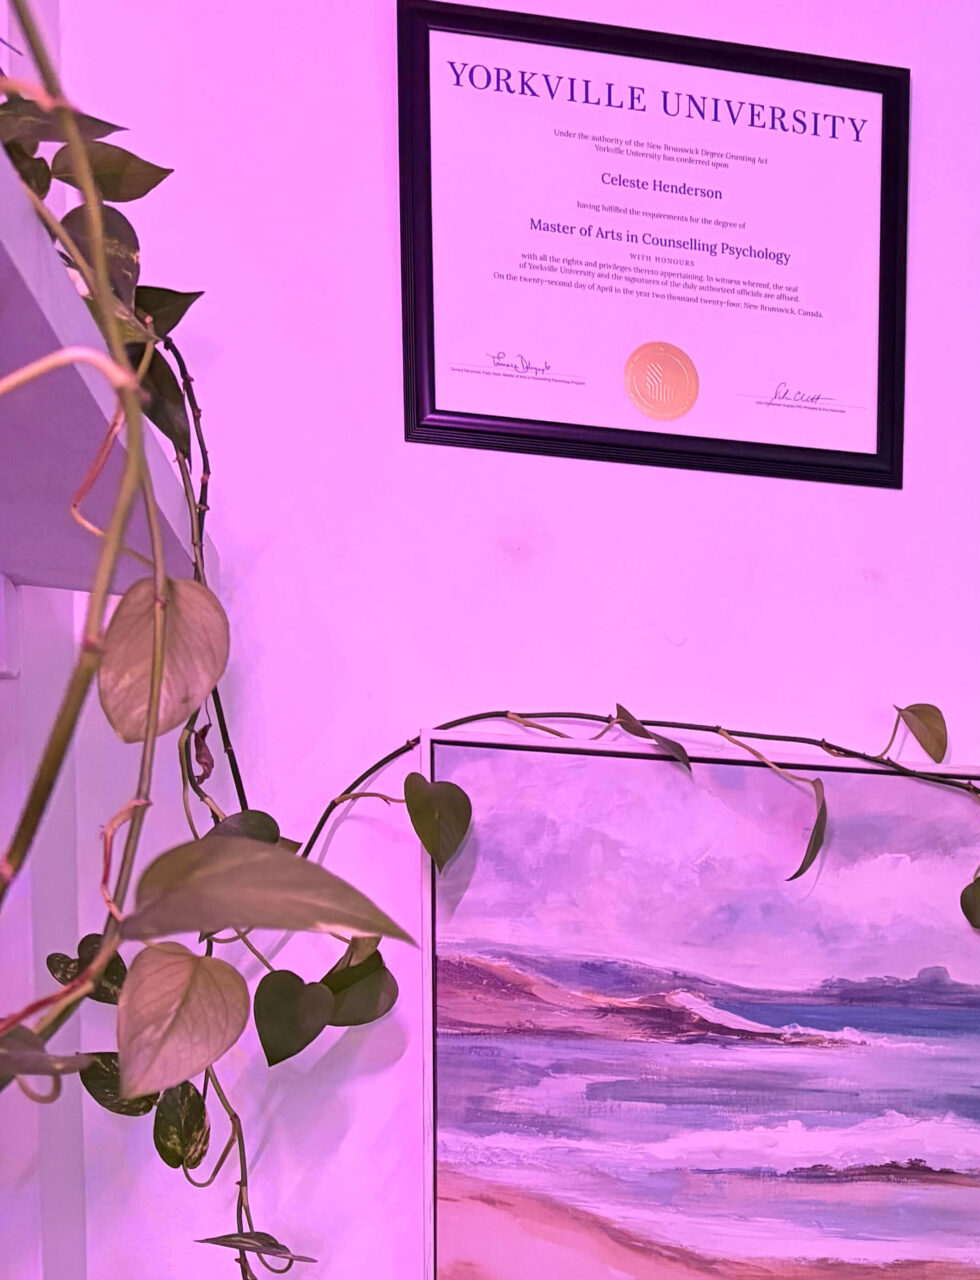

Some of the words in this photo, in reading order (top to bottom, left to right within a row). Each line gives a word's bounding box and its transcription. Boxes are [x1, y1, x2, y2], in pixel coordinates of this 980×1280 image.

[447, 60, 647, 113] YORKVILLE
[660, 90, 869, 143] UNIVERSITY
[553, 128, 576, 138] Under
[577, 131, 589, 140] the
[590, 135, 623, 148] authority
[624, 138, 632, 149] of
[633, 139, 644, 148] the
[646, 141, 662, 150] New
[663, 143, 699, 154] Brunswick
[700, 148, 724, 159] Degree
[725, 151, 755, 164] Granting
[757, 156, 767, 164] Act
[594, 143, 624, 155] Yorkville
[625, 148, 661, 161] University
[662, 153, 674, 161] has
[710, 156, 729, 169] upon
[601, 172, 648, 190] Celeste
[652, 179, 722, 199] Henderson
[576, 200, 600, 212] having
[601, 203, 627, 214] fulfilled
[628, 207, 640, 216] the
[641, 210, 688, 222] requirements
[689, 215, 699, 223] for
[713, 218, 737, 228] degree
[738, 221, 746, 229] of
[529, 217, 576, 234] Master
[579, 224, 593, 237] of
[595, 226, 622, 241] Arts
[626, 229, 638, 243] in
[641, 232, 717, 256] Counselling
[721, 242, 790, 265] Psychology
[629, 252, 651, 262] WITH
[654, 255, 694, 266] HONOURS
[518, 261, 527, 269] of
[527, 262, 558, 272] Yorkville
[559, 264, 595, 279] University
[596, 268, 610, 279] and
[611, 270, 623, 280] the
[623, 271, 659, 285] signatures
[660, 276, 669, 286] of
[668, 276, 681, 288] the
[682, 278, 697, 291] duly
[698, 280, 735, 294] authorized
[736, 288, 762, 298] officials
[763, 289, 775, 299] are
[520, 252, 537, 262] with
[538, 253, 547, 261] all
[548, 255, 560, 263] the
[562, 257, 583, 266] rights
[598, 262, 632, 273] privileges
[633, 265, 658, 275] thereto
[706, 274, 713, 284] In
[714, 277, 740, 285] witness
[772, 282, 783, 290] the
[493, 271, 504, 279] On
[505, 273, 517, 281] the
[519, 275, 572, 287] twenty-second
[573, 280, 586, 290] day
[587, 282, 595, 290] of
[596, 284, 612, 293] April
[622, 287, 634, 295] the
[651, 291, 665, 299] two
[666, 292, 698, 303] thousand
[743, 301, 758, 309] New
